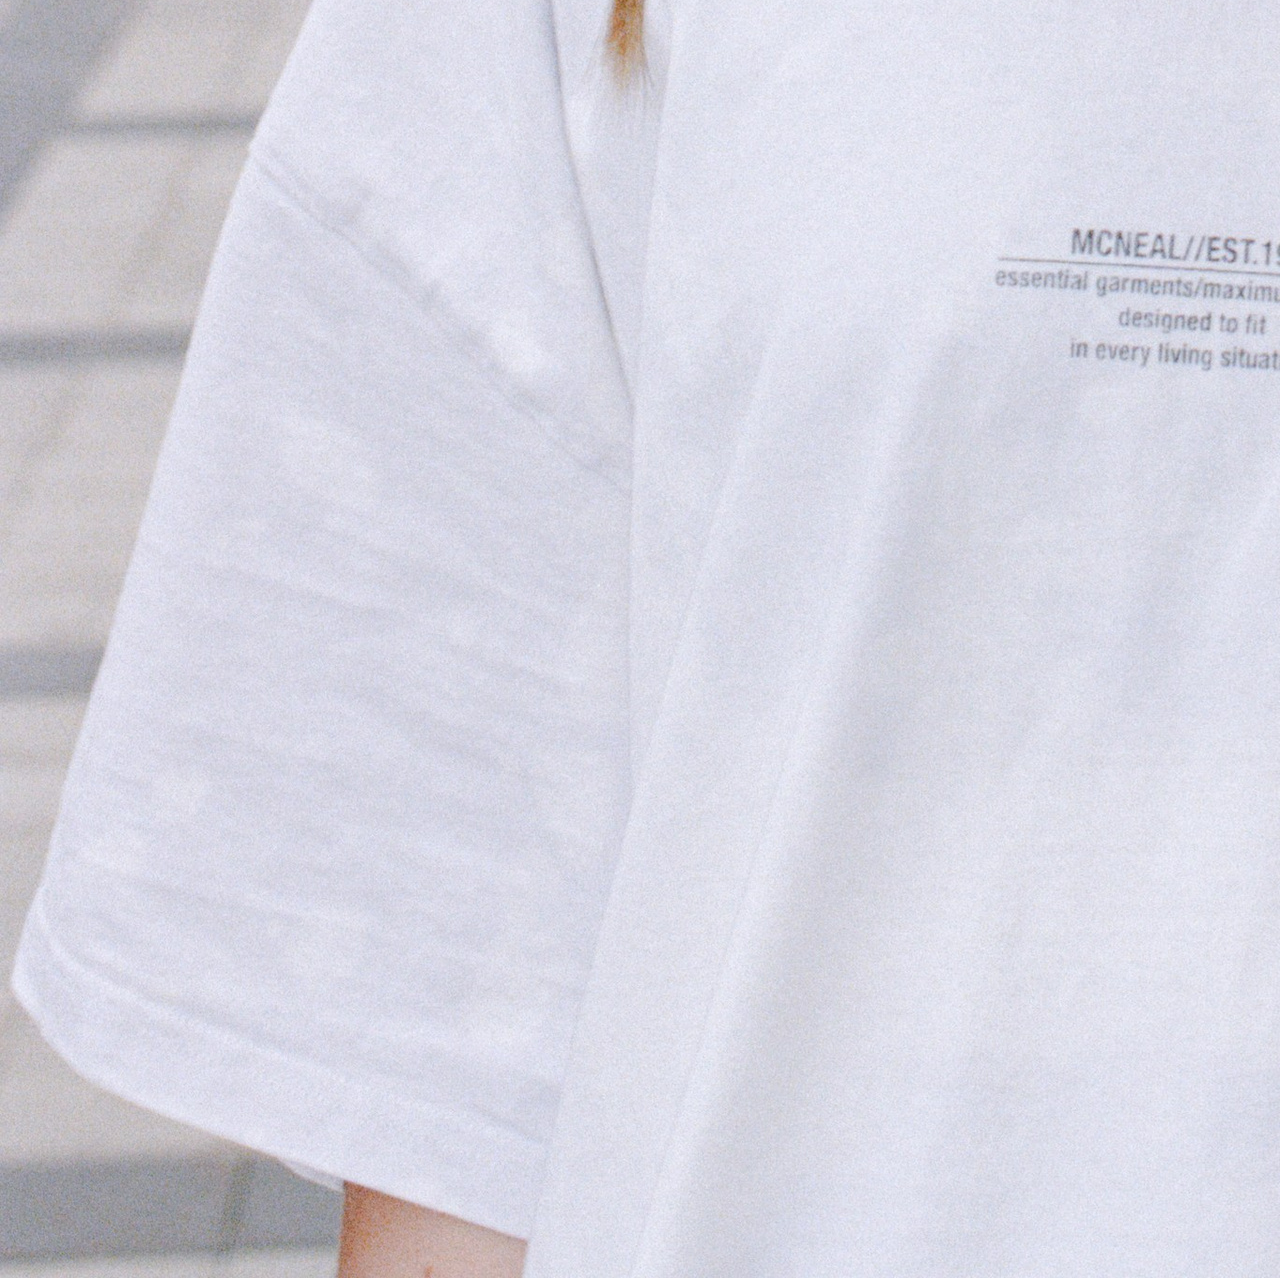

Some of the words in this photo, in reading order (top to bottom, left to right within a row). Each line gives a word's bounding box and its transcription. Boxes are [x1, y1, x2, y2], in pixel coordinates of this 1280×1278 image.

[994, 267, 1088, 291] essential
[1118, 306, 1212, 333] designed
[1219, 314, 1239, 333] to
[1244, 314, 1268, 334] fit
[1070, 338, 1089, 359] in
[1095, 344, 1151, 367] every
[1157, 342, 1213, 371] living
